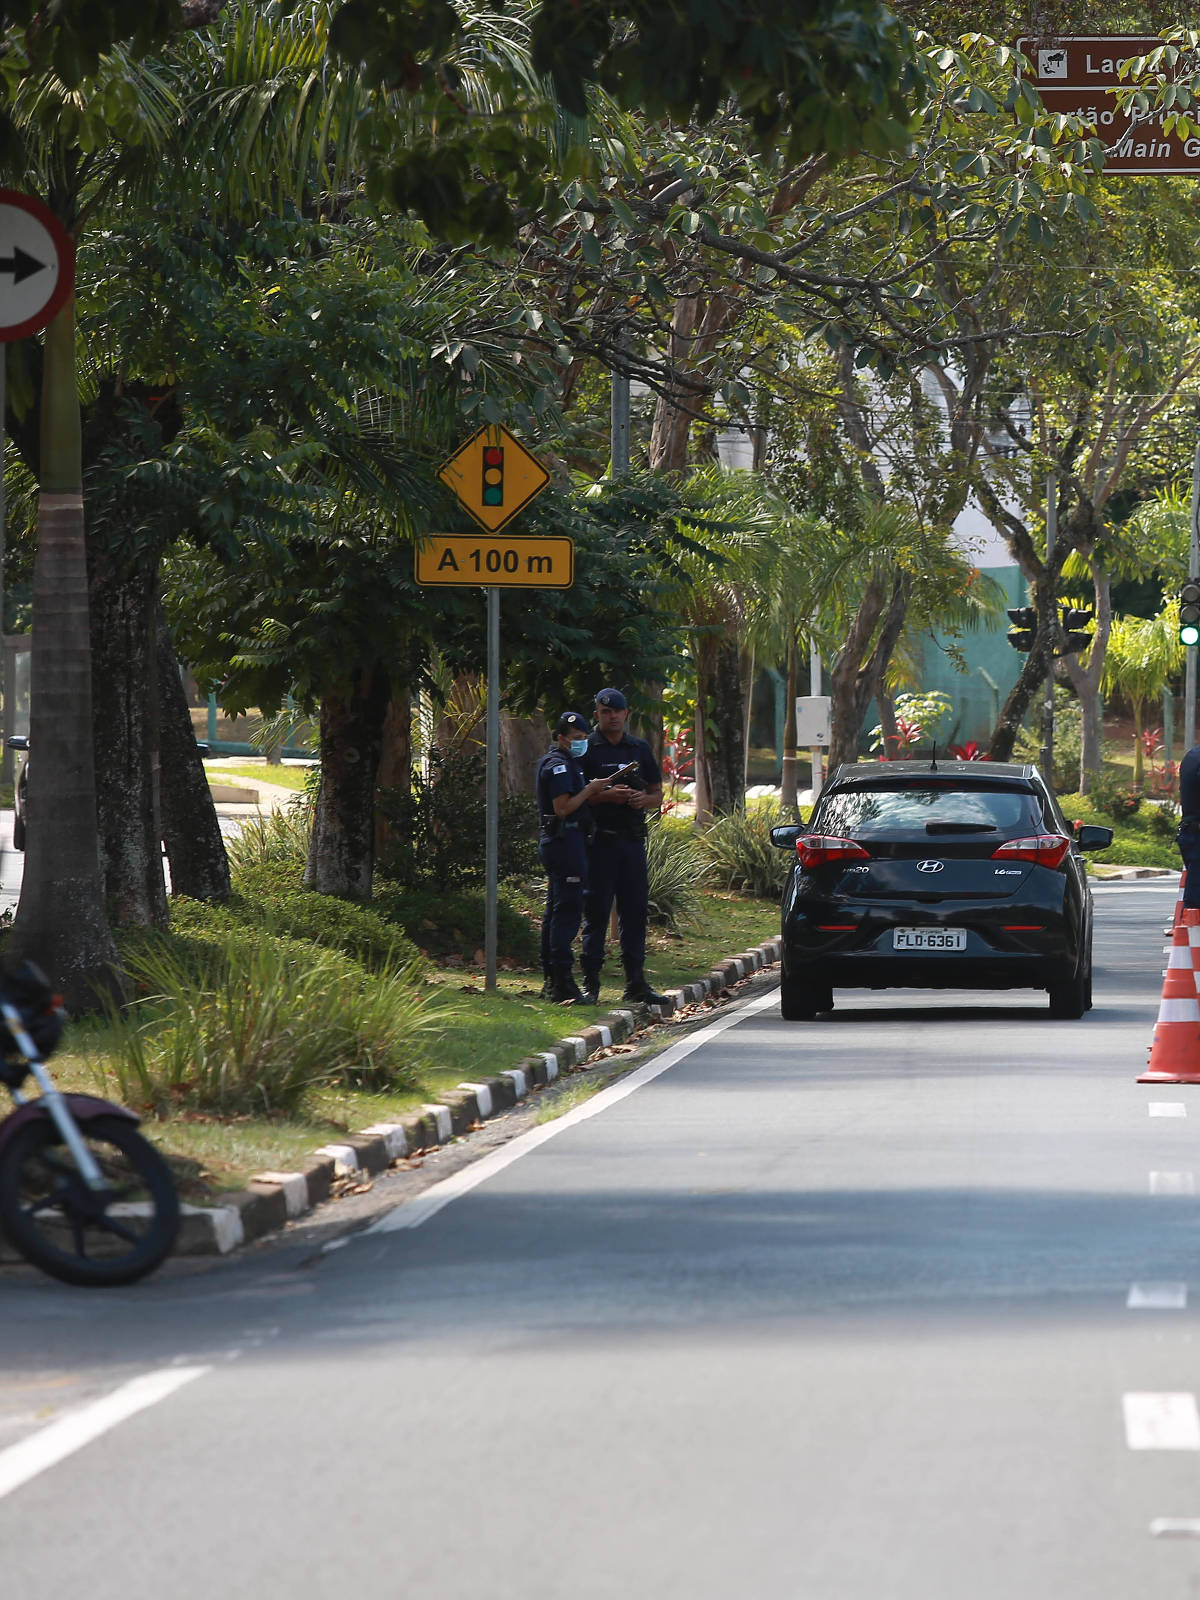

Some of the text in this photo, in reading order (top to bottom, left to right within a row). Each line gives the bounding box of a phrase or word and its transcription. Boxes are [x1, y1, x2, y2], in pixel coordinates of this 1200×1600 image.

[1085, 54, 1160, 78] Laga
[1033, 106, 1114, 125] tão
[1113, 138, 1171, 158] Main
[437, 548, 553, 573] A 100 m
